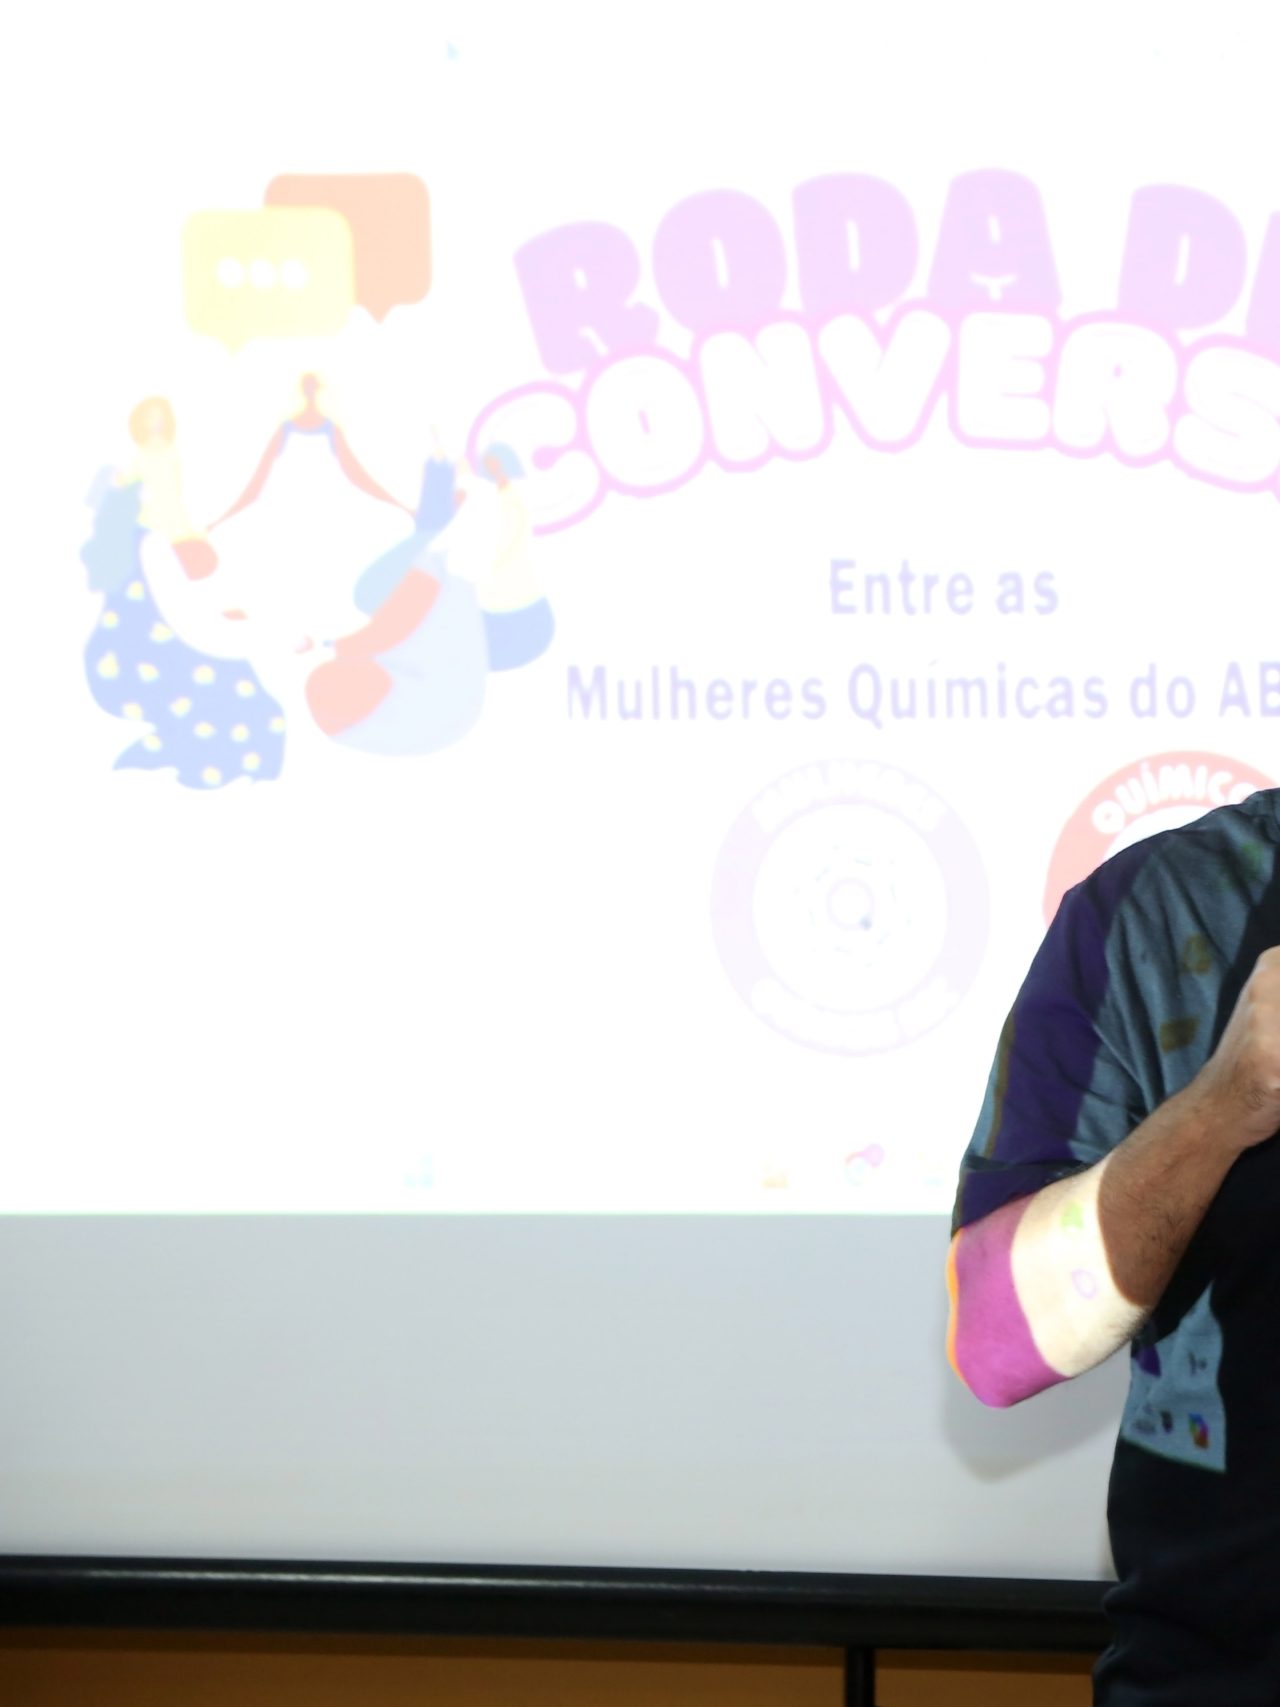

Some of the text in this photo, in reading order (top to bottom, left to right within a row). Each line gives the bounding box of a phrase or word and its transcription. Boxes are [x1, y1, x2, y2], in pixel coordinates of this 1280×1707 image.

[512, 166, 1063, 376] RODA
[828, 557, 1060, 617] Entre as
[565, 664, 828, 722] Mulheres
[847, 658, 1110, 730] Químicas
[1129, 662, 1197, 719] do
